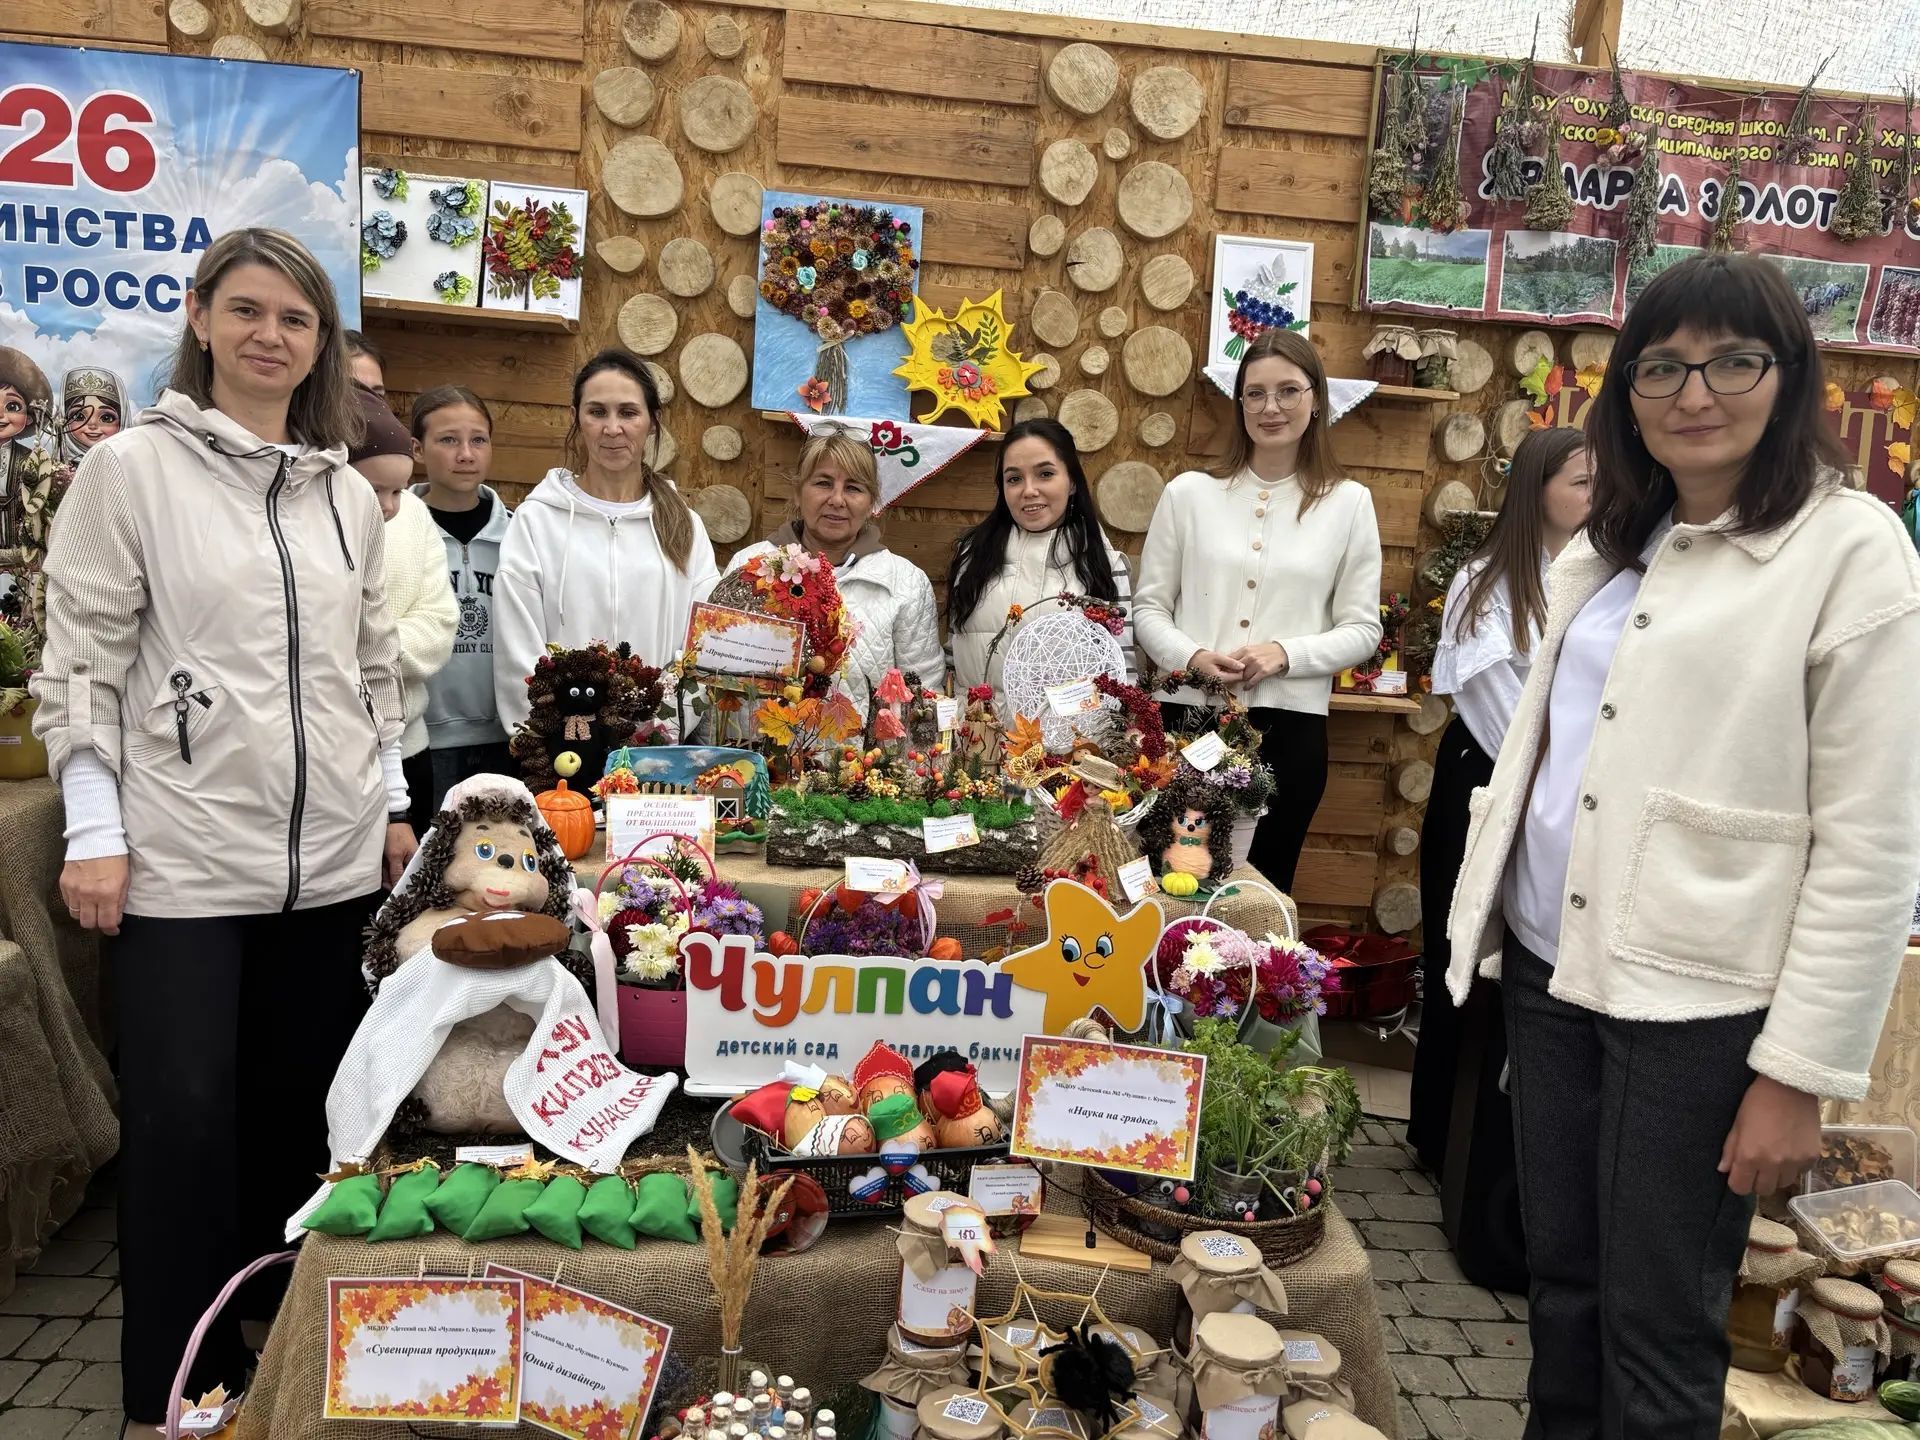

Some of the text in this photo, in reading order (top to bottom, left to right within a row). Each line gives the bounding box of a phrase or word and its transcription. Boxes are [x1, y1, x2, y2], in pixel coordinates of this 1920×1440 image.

[626, 810, 696, 818] ПРЕДСКАЗАНИЕ
[685, 942, 1014, 1027] Чулпан
[716, 1038, 797, 1056] детский
[804, 1040, 839, 1058] сад
[1068, 1105, 1159, 1127] «Наука на грядке»
[365, 1343, 496, 1358] «Сувенирная продукция»
[555, 1363, 607, 1392] дизайнер»
